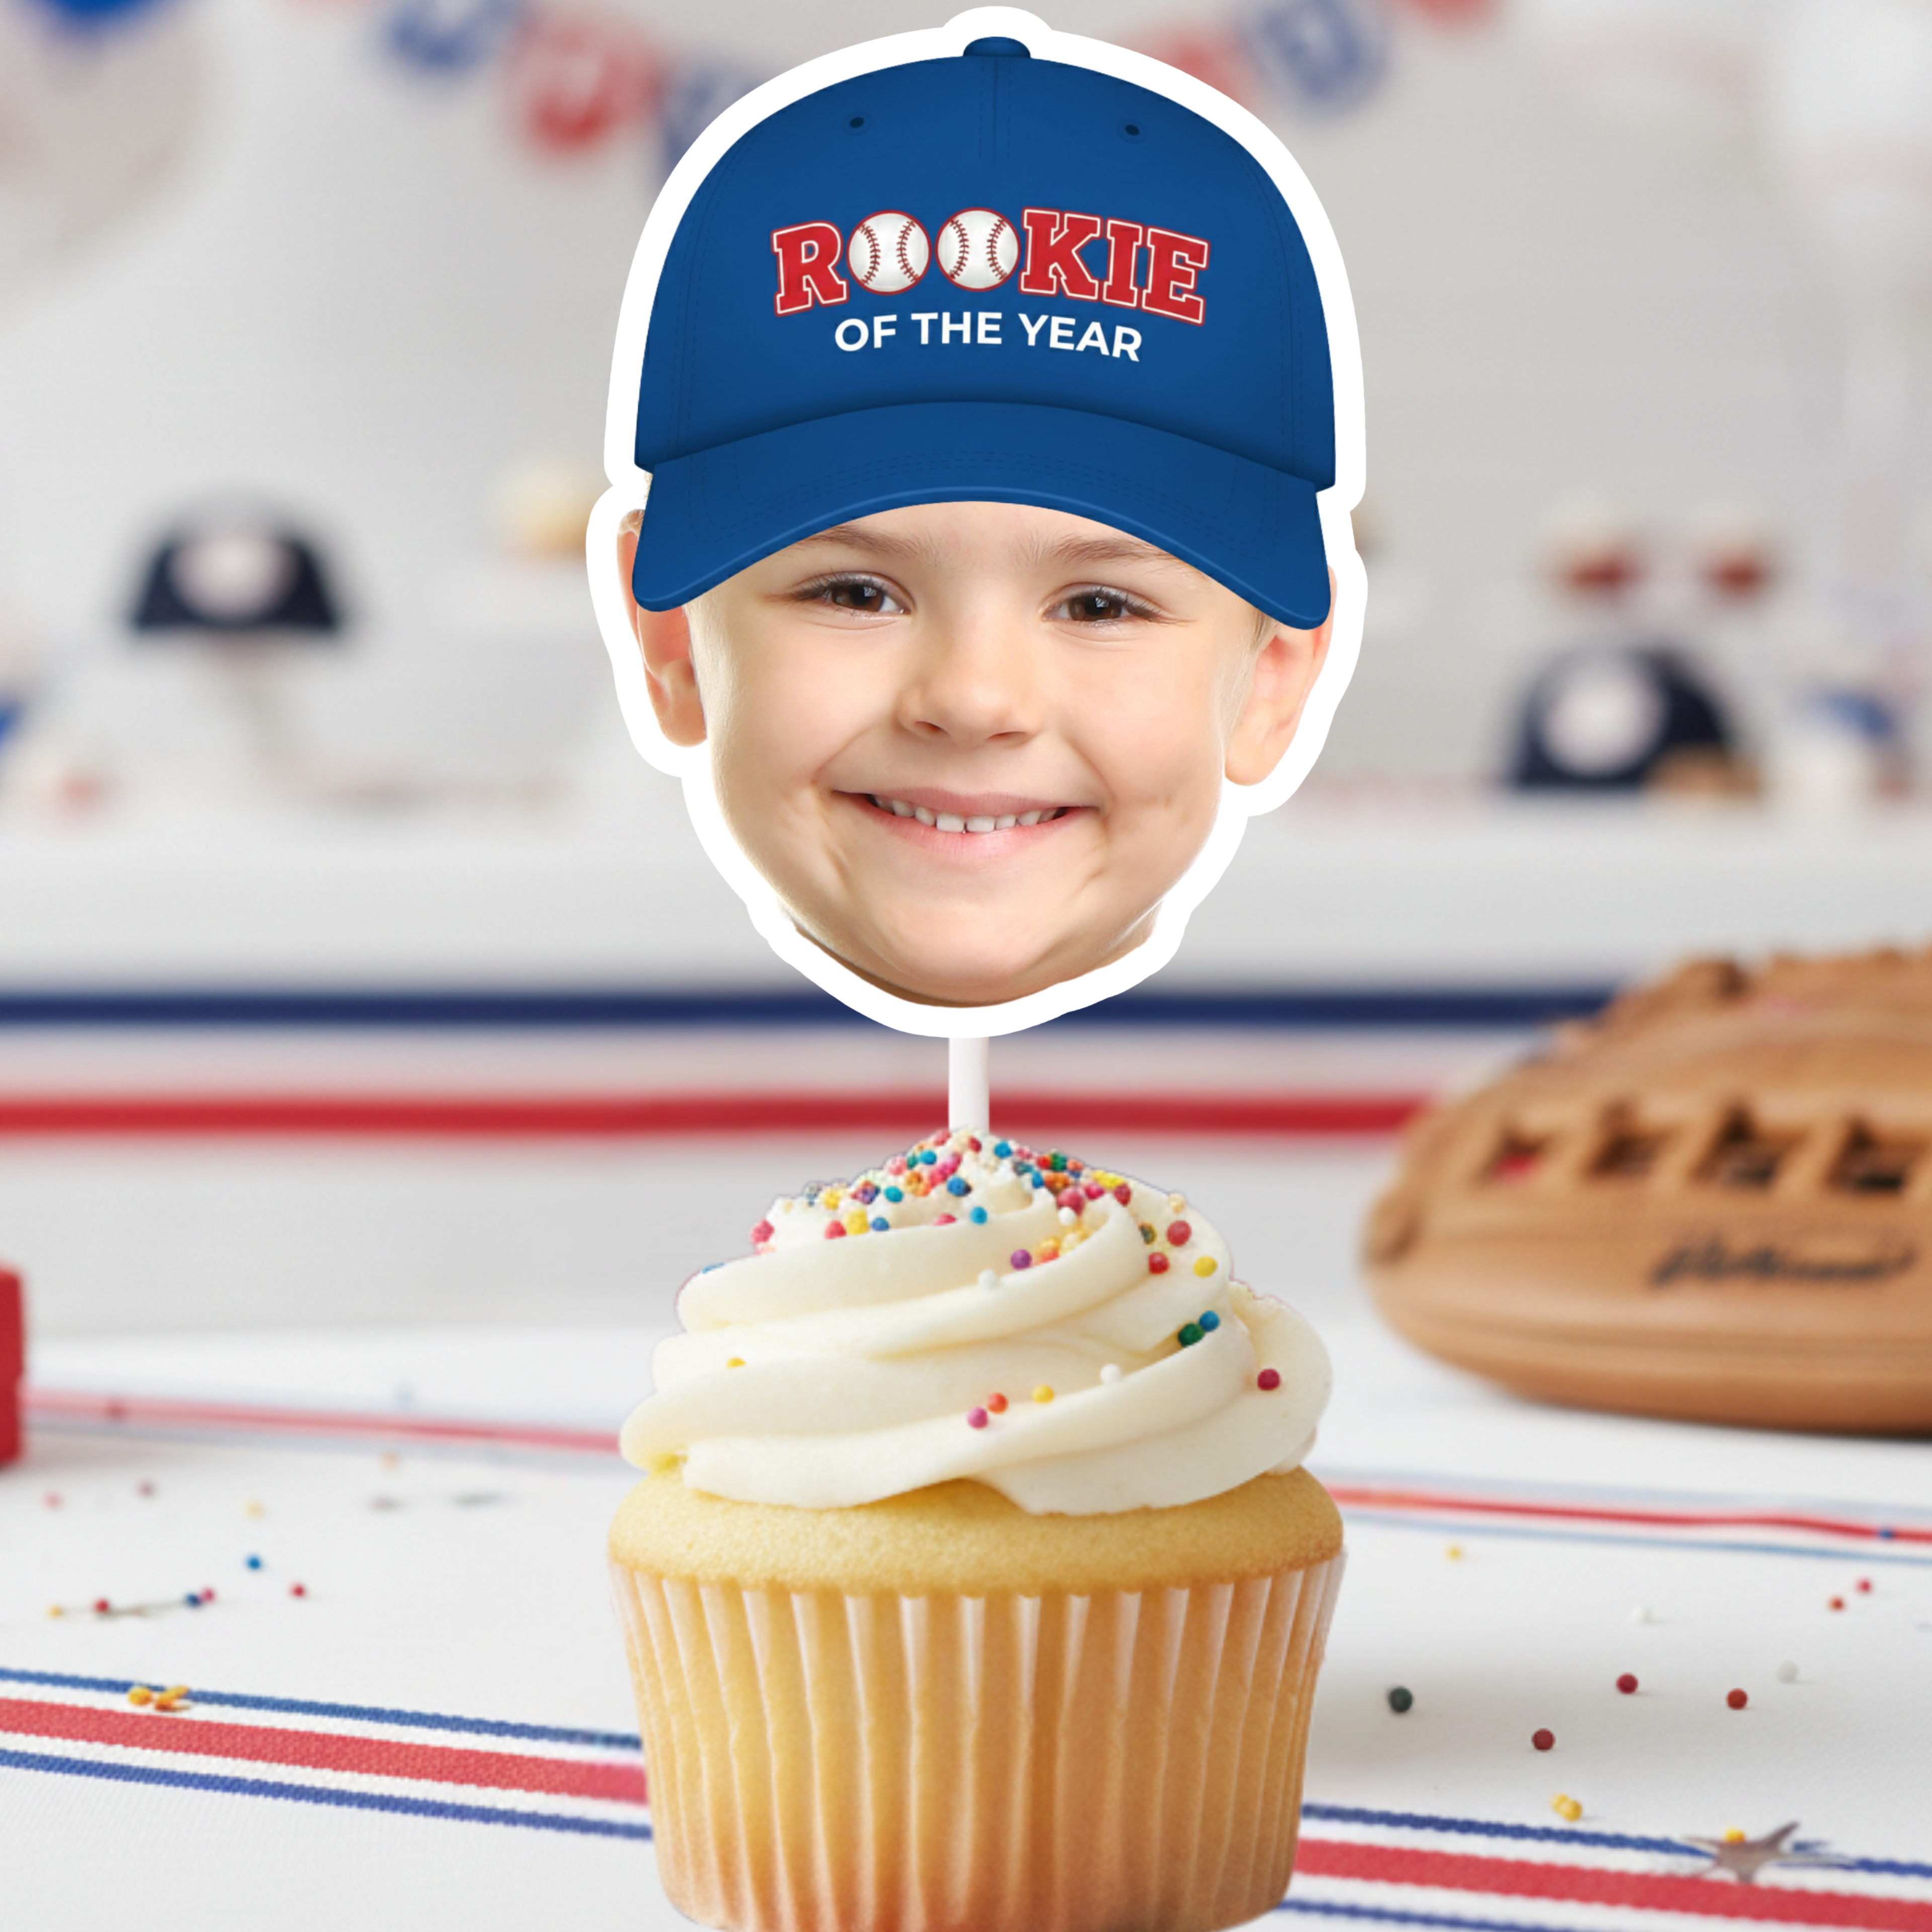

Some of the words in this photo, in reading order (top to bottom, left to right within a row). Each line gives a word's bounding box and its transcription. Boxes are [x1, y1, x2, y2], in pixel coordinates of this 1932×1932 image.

[771, 207, 1210, 326] ROOKIE
[835, 314, 897, 351] OF
[911, 312, 1002, 344] THE
[1018, 313, 1142, 362] YEAR
